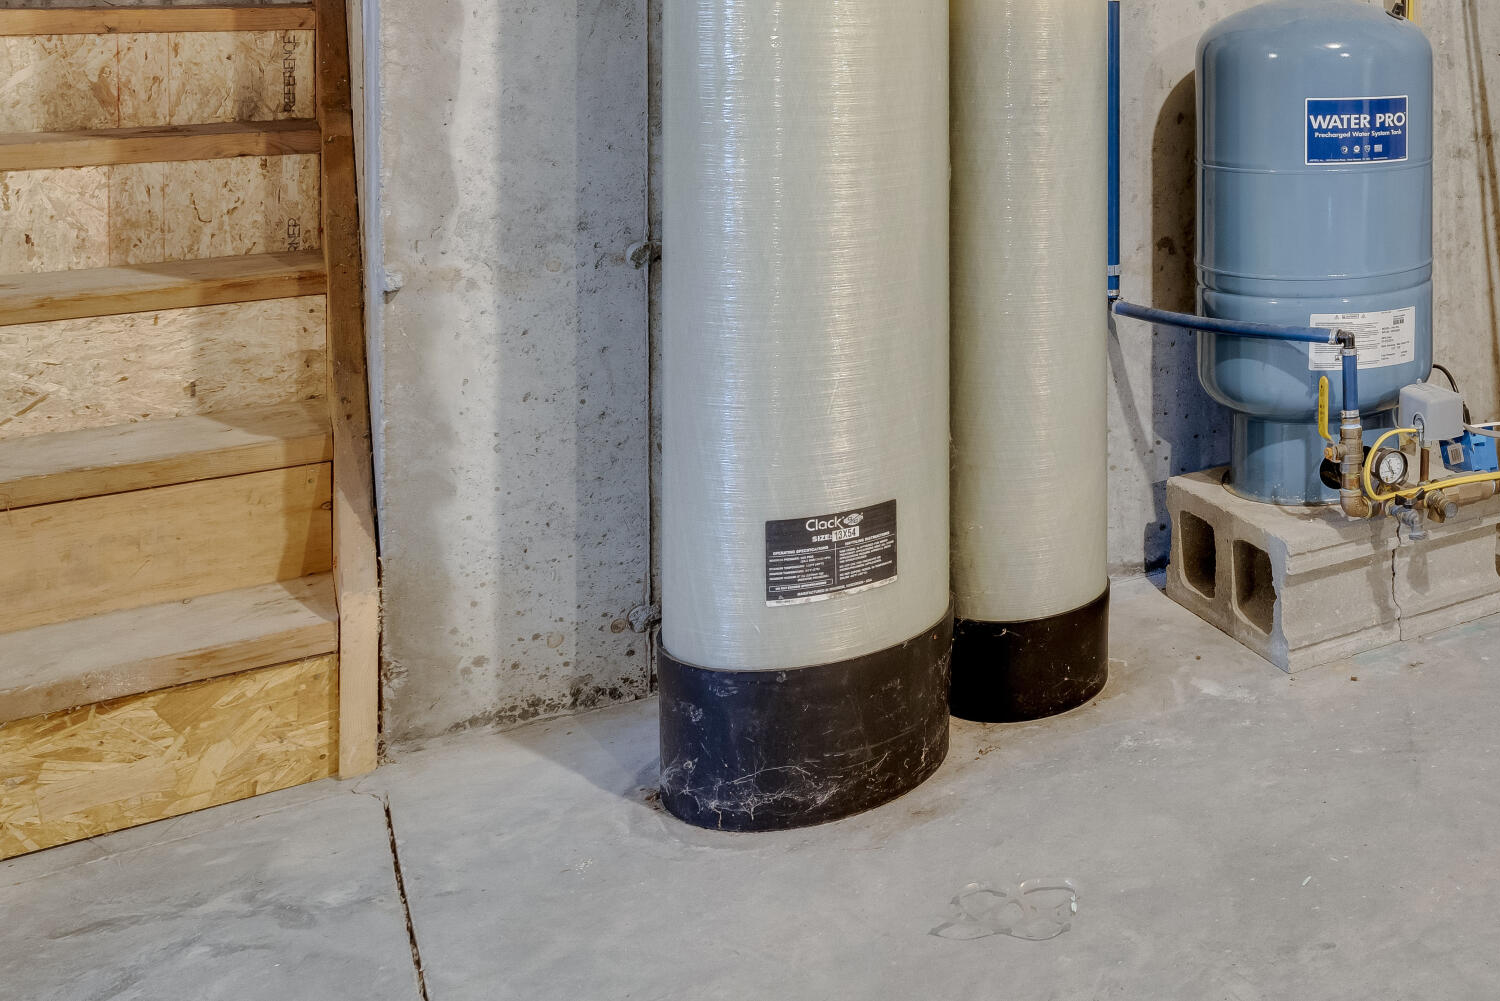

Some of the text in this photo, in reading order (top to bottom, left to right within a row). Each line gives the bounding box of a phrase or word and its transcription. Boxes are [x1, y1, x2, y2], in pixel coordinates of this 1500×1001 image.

[283, 35, 296, 113] REFERENCE
[1309, 112, 1406, 129] WATER PRO
[1314, 131, 1351, 139] Precharged
[1371, 130, 1390, 138] System
[806, 516, 842, 531] Clack
[833, 528, 857, 541] 13X54
